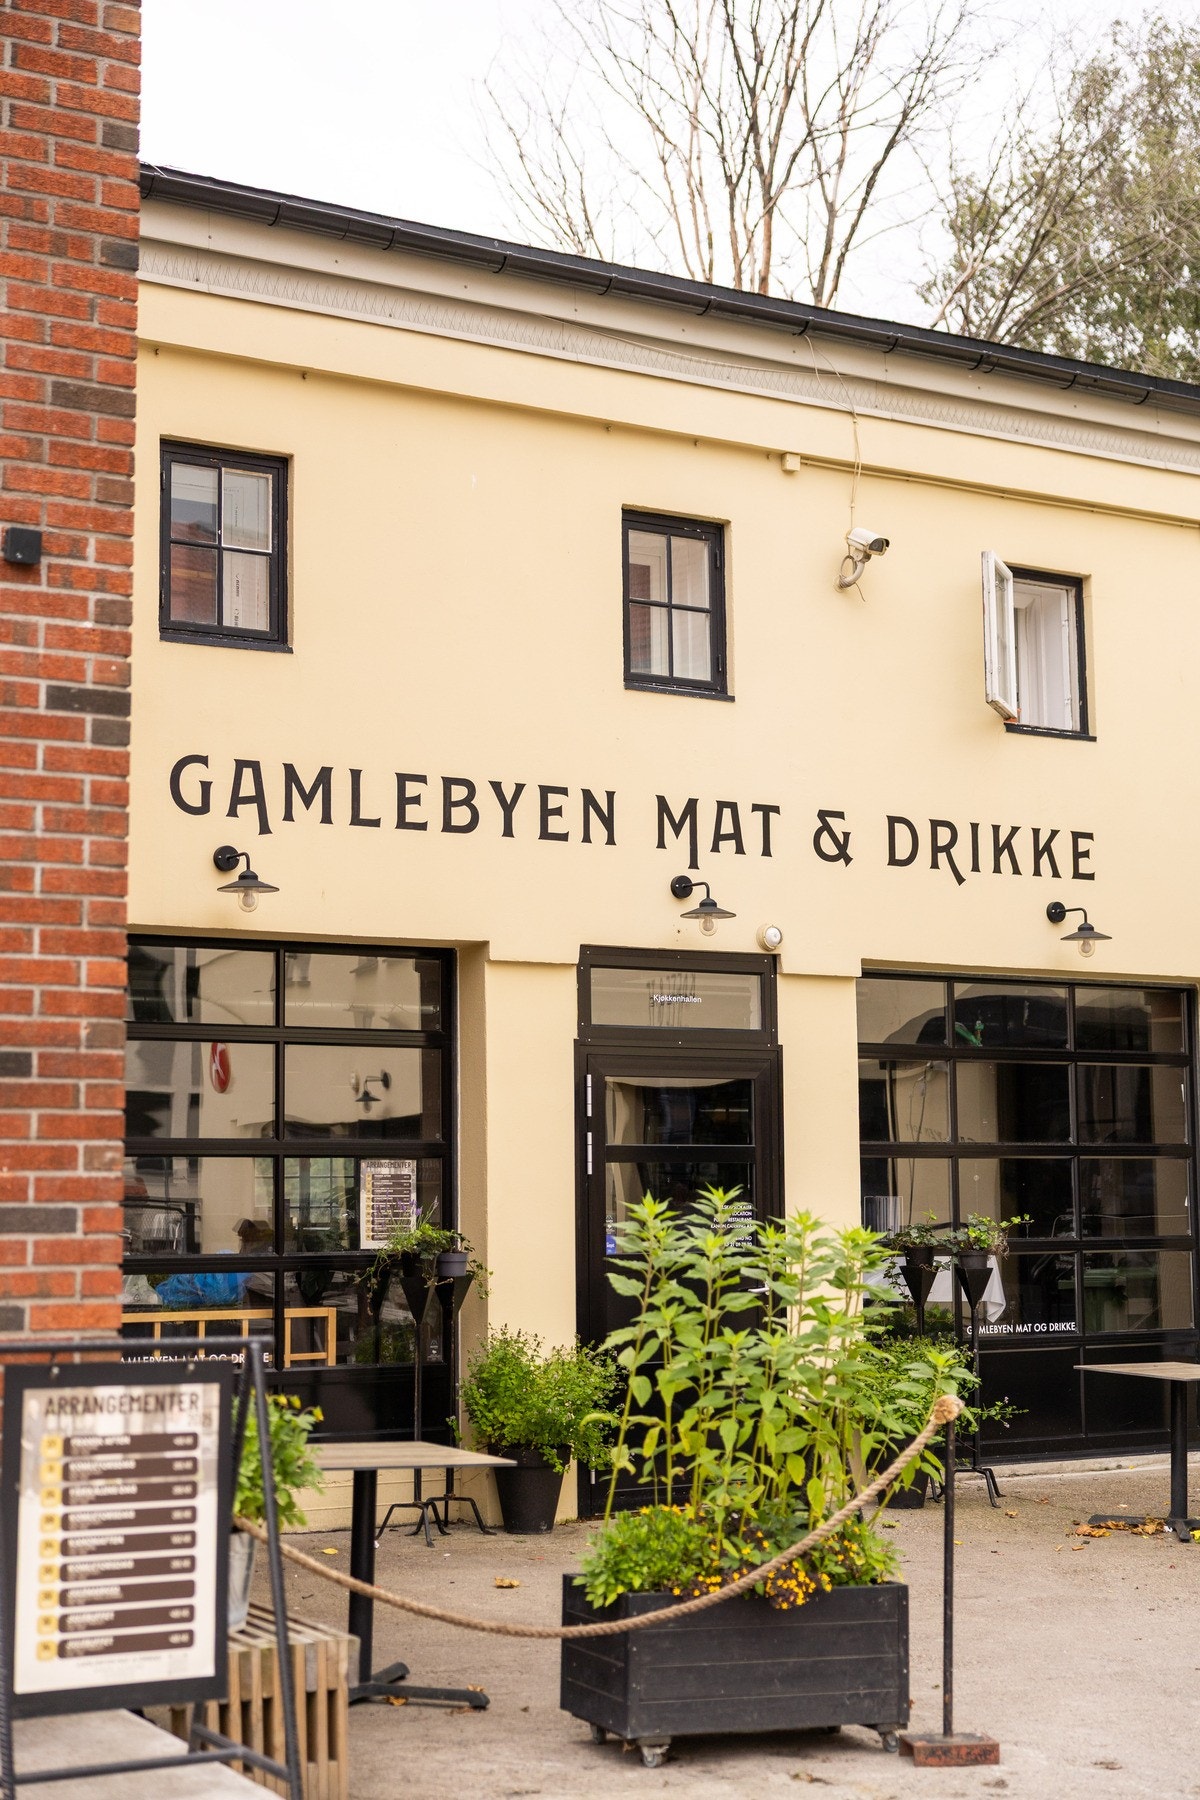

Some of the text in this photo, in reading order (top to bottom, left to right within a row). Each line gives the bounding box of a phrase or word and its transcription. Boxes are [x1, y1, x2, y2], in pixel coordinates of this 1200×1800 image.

[169, 754, 1096, 886] GAMLEBYEN MAT & DRIKKE
[966, 1321, 1076, 1335] GMLEBYEN MAT OG DRIKKE
[45, 1391, 200, 1417] ARRANGEMENTER
